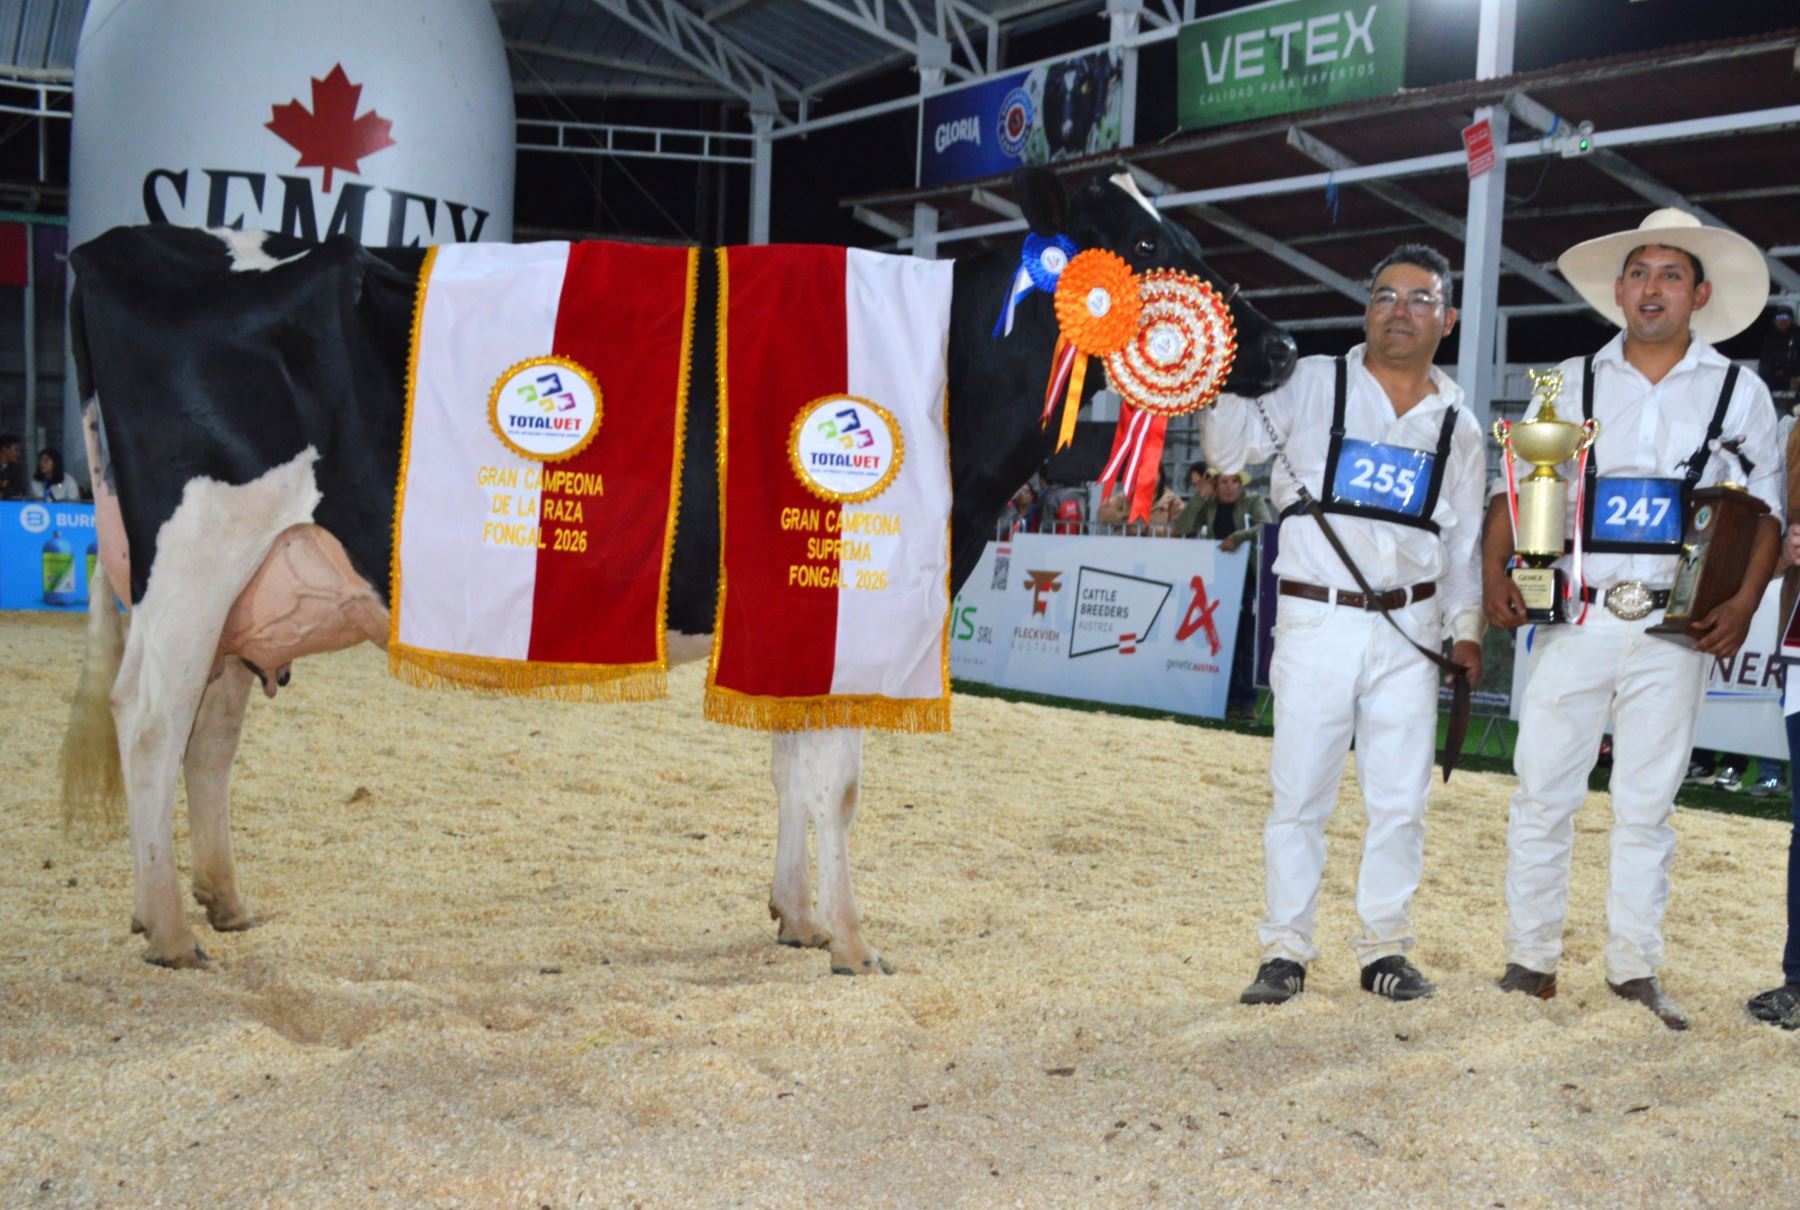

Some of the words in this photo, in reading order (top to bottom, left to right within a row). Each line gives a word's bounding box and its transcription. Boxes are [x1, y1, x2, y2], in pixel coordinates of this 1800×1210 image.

[1201, 5, 1378, 85] VETEX
[1200, 86, 1254, 105] CALIDAD
[1262, 78, 1295, 93] PARA
[1302, 62, 1375, 87] EXPERTOS
[935, 115, 981, 153] GLORIA
[509, 414, 582, 431] TOTALVET
[810, 452, 880, 469] TOTALVET
[477, 466, 518, 488] GRAN
[524, 468, 604, 496] CAMPEONA
[1350, 458, 1416, 498] 255
[492, 494, 512, 515] DE
[517, 496, 537, 517] LA
[543, 499, 584, 523] RAZA
[780, 507, 820, 532] GRAN
[825, 509, 902, 536] CAMPEONA
[1605, 495, 1672, 527] 247
[483, 522, 547, 549] FONGAL
[553, 528, 588, 552] 2026
[807, 537, 872, 562] SUPREMA
[788, 565, 848, 588] FONGAL
[855, 569, 888, 591] 2026
[1082, 588, 1117, 602] CATTLE
[1080, 603, 1129, 619] BREEDERS
[1013, 626, 1060, 641] FLECKVIEH
[1078, 621, 1113, 633] AUSTRIA
